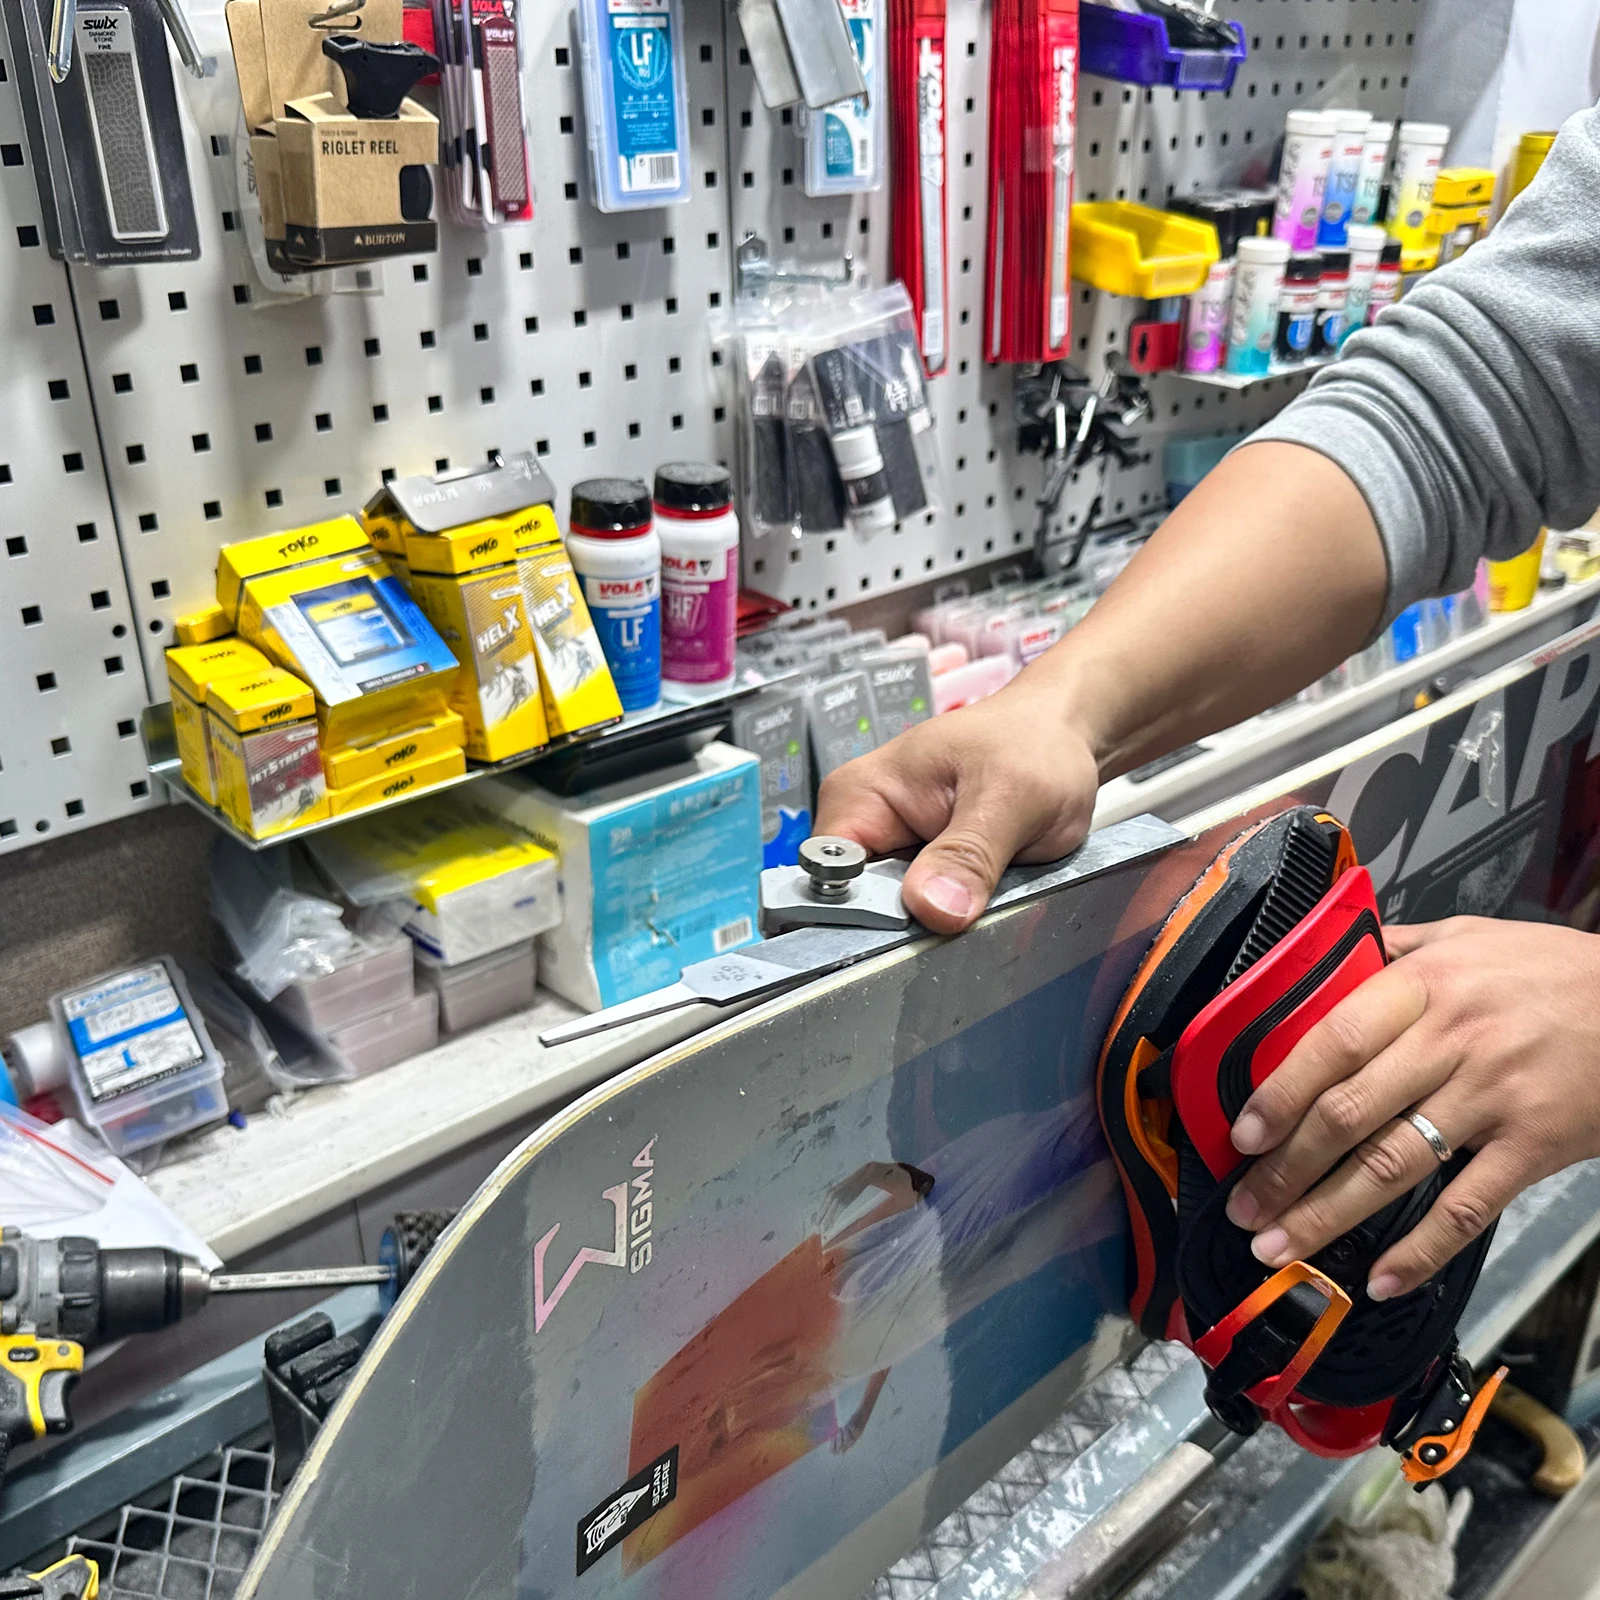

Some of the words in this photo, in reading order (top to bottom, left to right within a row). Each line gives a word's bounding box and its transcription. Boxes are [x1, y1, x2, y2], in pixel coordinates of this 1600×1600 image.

[630, 32, 654, 66] LF
[322, 140, 366, 156] RIGLET
[370, 140, 399, 155] REEL
[364, 232, 406, 247] BURTON
[514, 519, 541, 538] TOKO
[278, 535, 319, 558] TOKO
[469, 538, 499, 560] TOKO
[661, 556, 698, 571] OLA
[599, 580, 645, 599] VOLA
[620, 618, 645, 648] LF
[261, 702, 293, 722] TOKO
[385, 744, 418, 767] TOKO
[630, 1138, 656, 1274] SIGMA
[652, 1464, 662, 1507] SCAN
[660, 1459, 671, 1499] HERE
